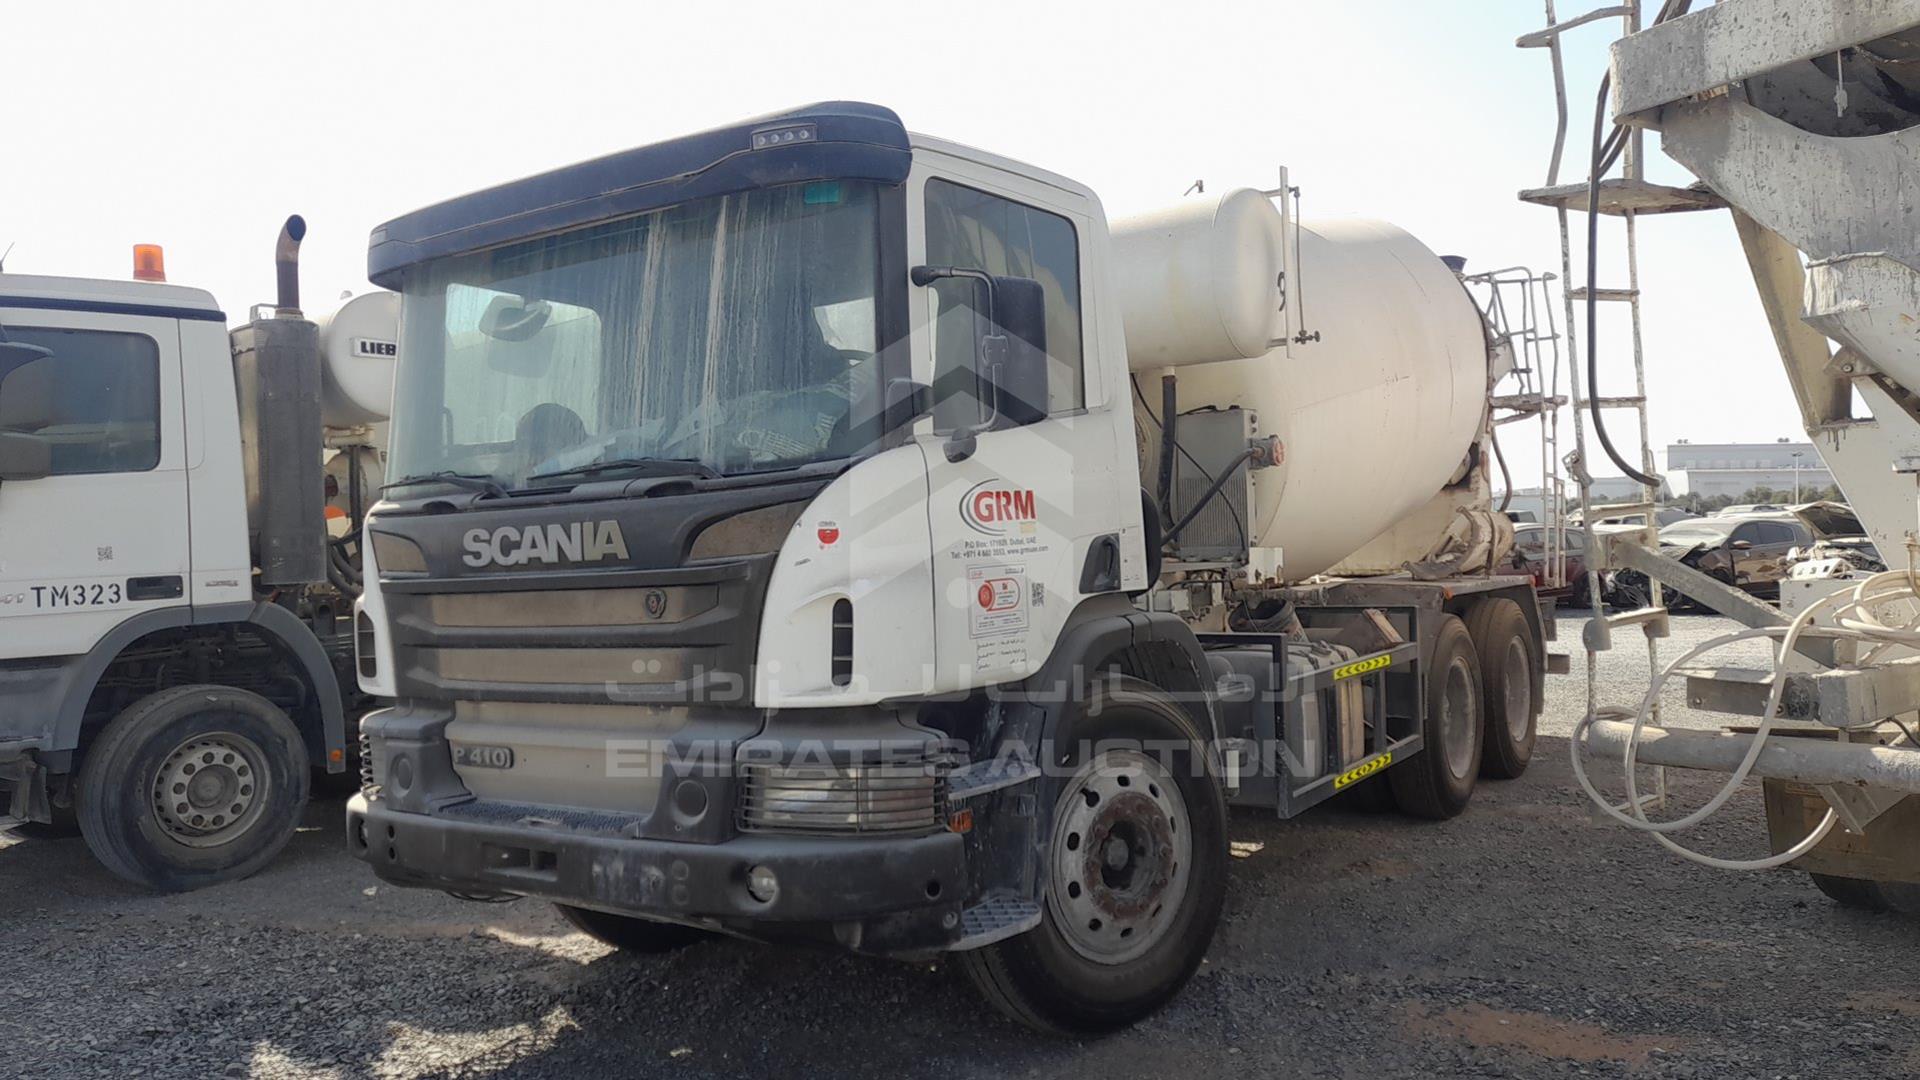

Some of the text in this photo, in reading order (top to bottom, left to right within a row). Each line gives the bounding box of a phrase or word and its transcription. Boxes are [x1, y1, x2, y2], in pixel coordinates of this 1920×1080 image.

[973, 489, 1036, 523] GRM
[462, 519, 630, 568] SCANIA
[30, 583, 121, 608] TM323
[470, 747, 506, 767] 410
